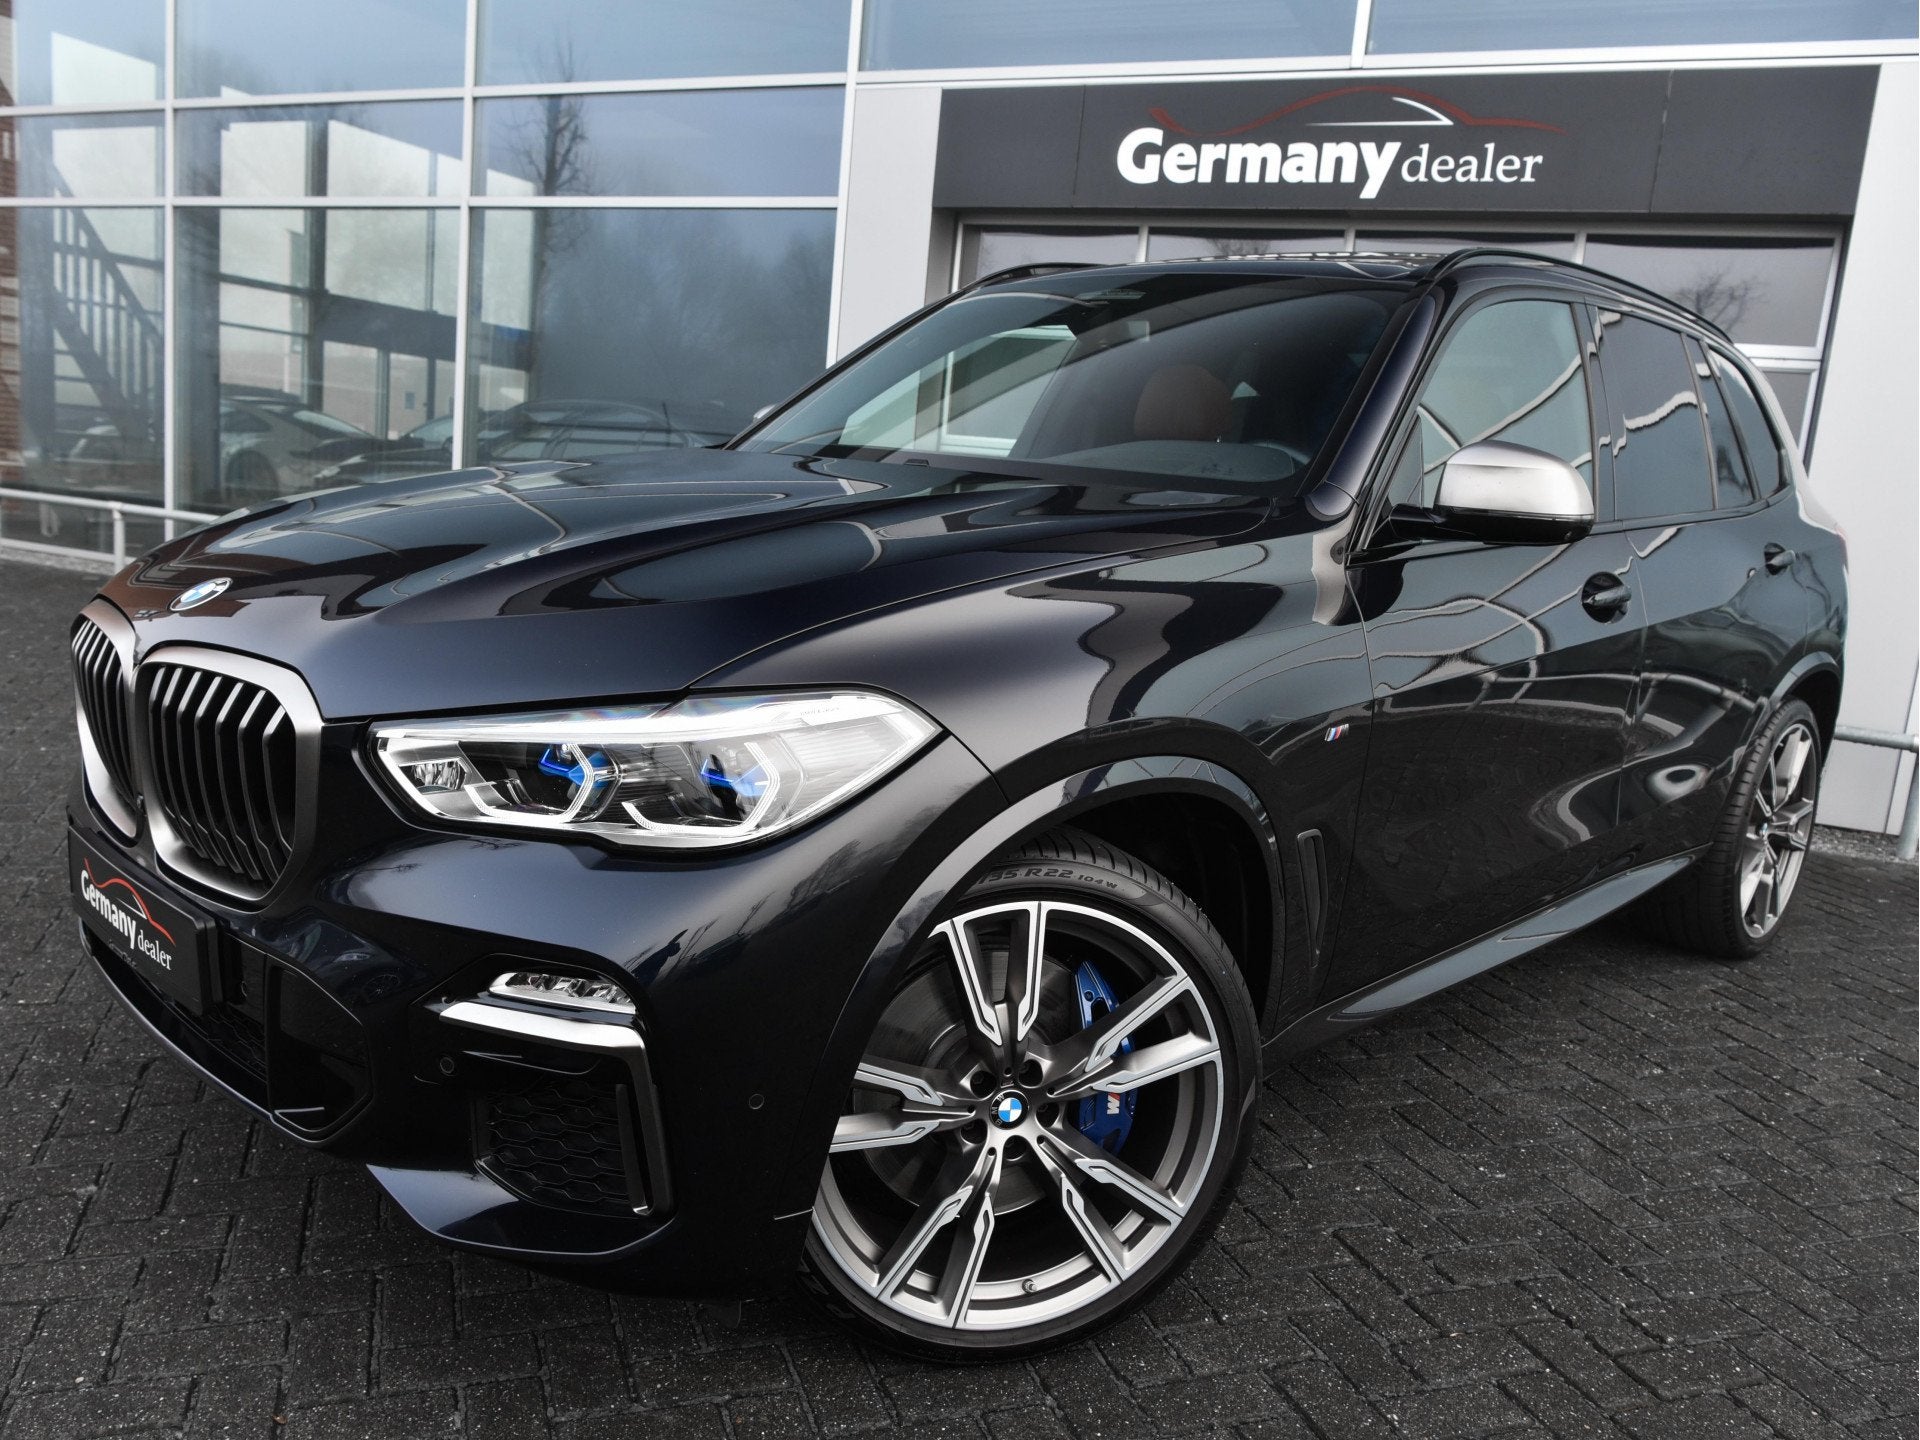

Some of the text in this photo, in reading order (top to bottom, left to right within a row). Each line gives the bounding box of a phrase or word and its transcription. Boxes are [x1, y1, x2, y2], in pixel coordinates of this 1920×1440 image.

[1117, 127, 1543, 199] Germany dealer
[1024, 867, 1074, 879] R22
[81, 869, 137, 949] Germany
[137, 930, 172, 970] dealer
